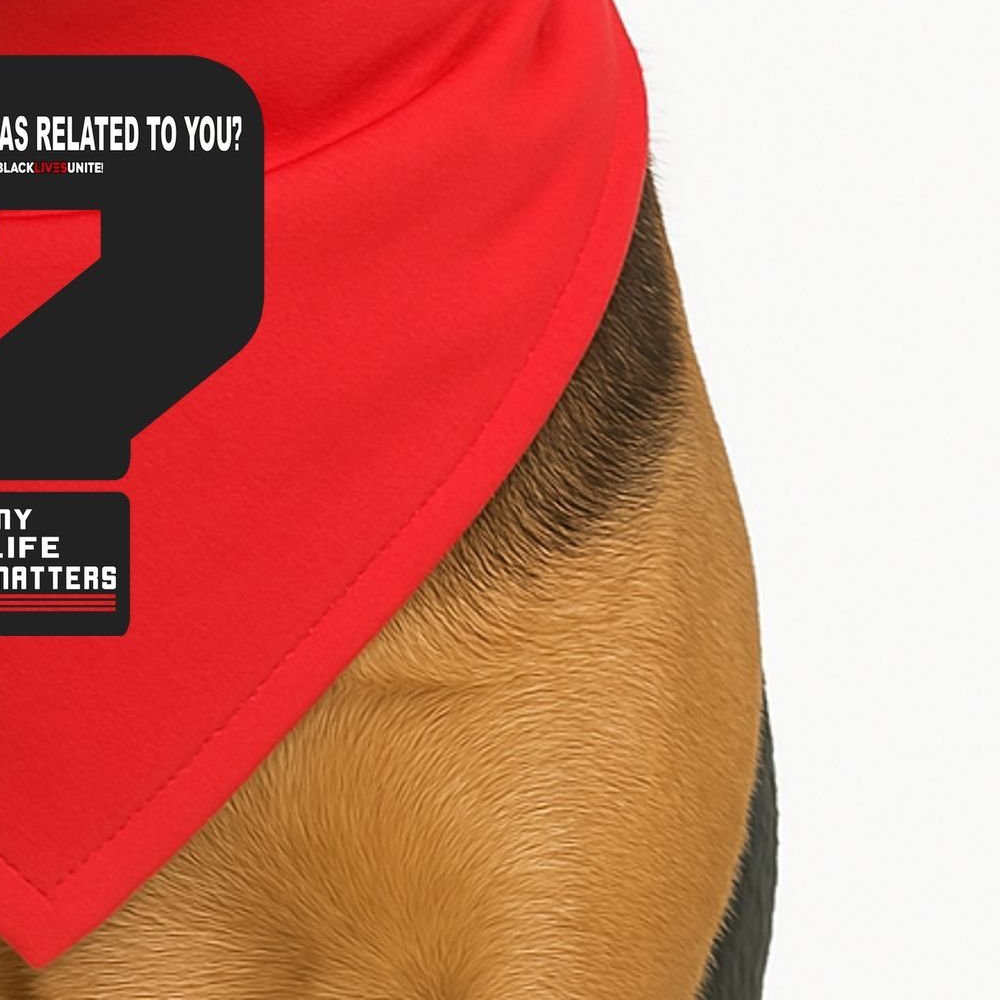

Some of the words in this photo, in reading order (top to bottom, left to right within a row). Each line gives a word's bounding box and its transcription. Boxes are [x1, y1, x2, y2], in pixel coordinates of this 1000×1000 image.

[36, 115, 140, 151] RELATED
[146, 115, 177, 152] TO
[184, 115, 242, 152] YOU?
